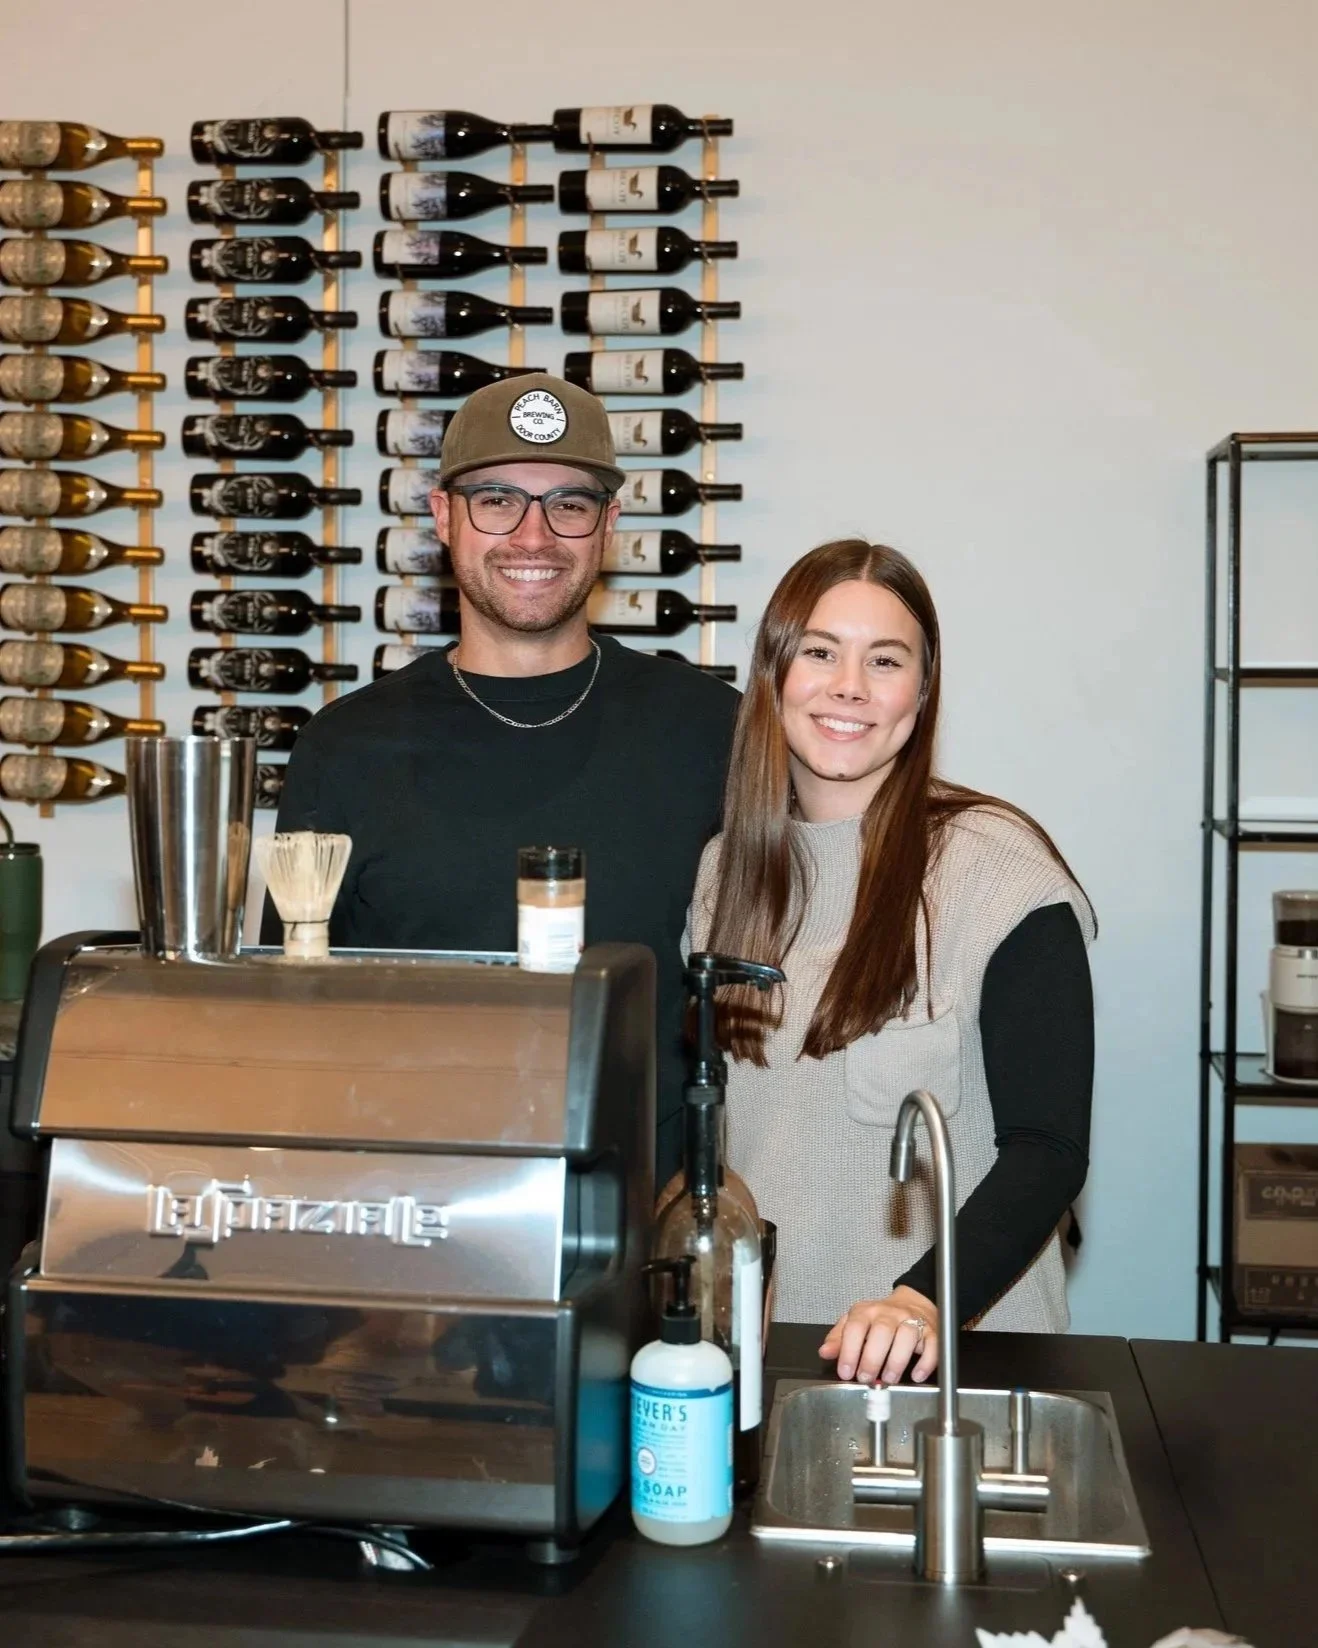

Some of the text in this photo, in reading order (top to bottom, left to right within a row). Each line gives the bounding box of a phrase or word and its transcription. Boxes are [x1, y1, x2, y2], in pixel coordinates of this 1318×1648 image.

[514, 393, 563, 414] PEACH BARN
[522, 411, 555, 420] BREWING
[516, 424, 561, 441] DOOR COUNTY
[643, 1479, 687, 1497] SOAP
